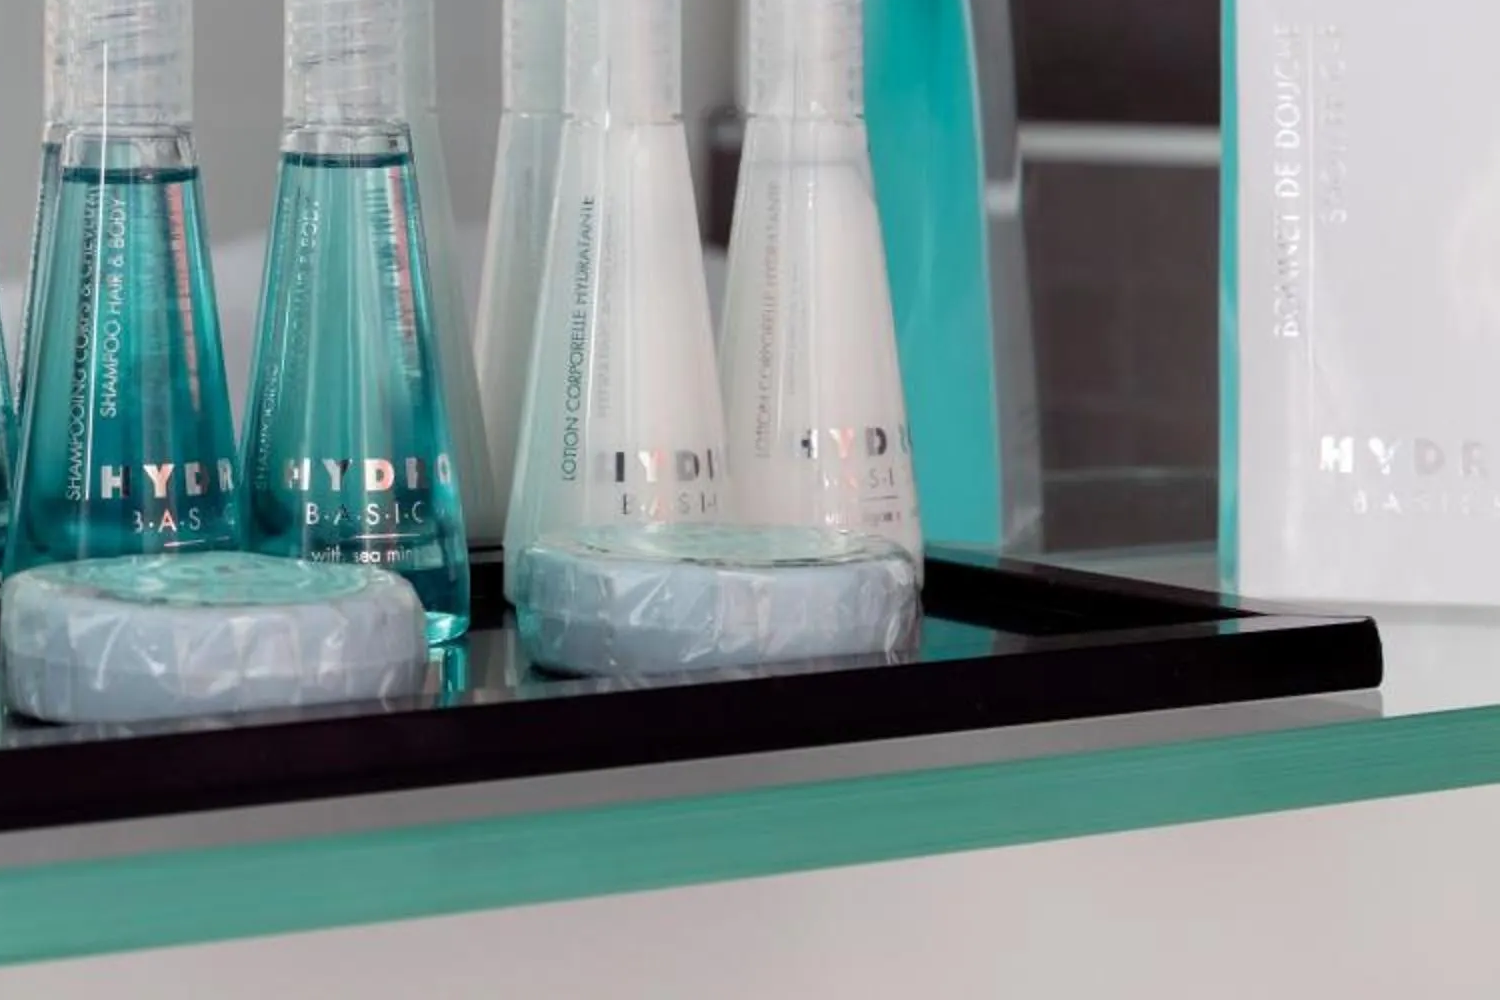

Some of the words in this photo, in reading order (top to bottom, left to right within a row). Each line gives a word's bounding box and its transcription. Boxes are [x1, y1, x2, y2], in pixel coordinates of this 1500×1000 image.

[1273, 23, 1301, 150] DOUCHE
[1273, 161, 1301, 198] DE
[109, 198, 128, 249] BODY
[105, 273, 125, 315] HAIR
[100, 320, 121, 419] SHAMPOO
[563, 309, 588, 413] CORPORELLE
[560, 416, 581, 482] LOTION
